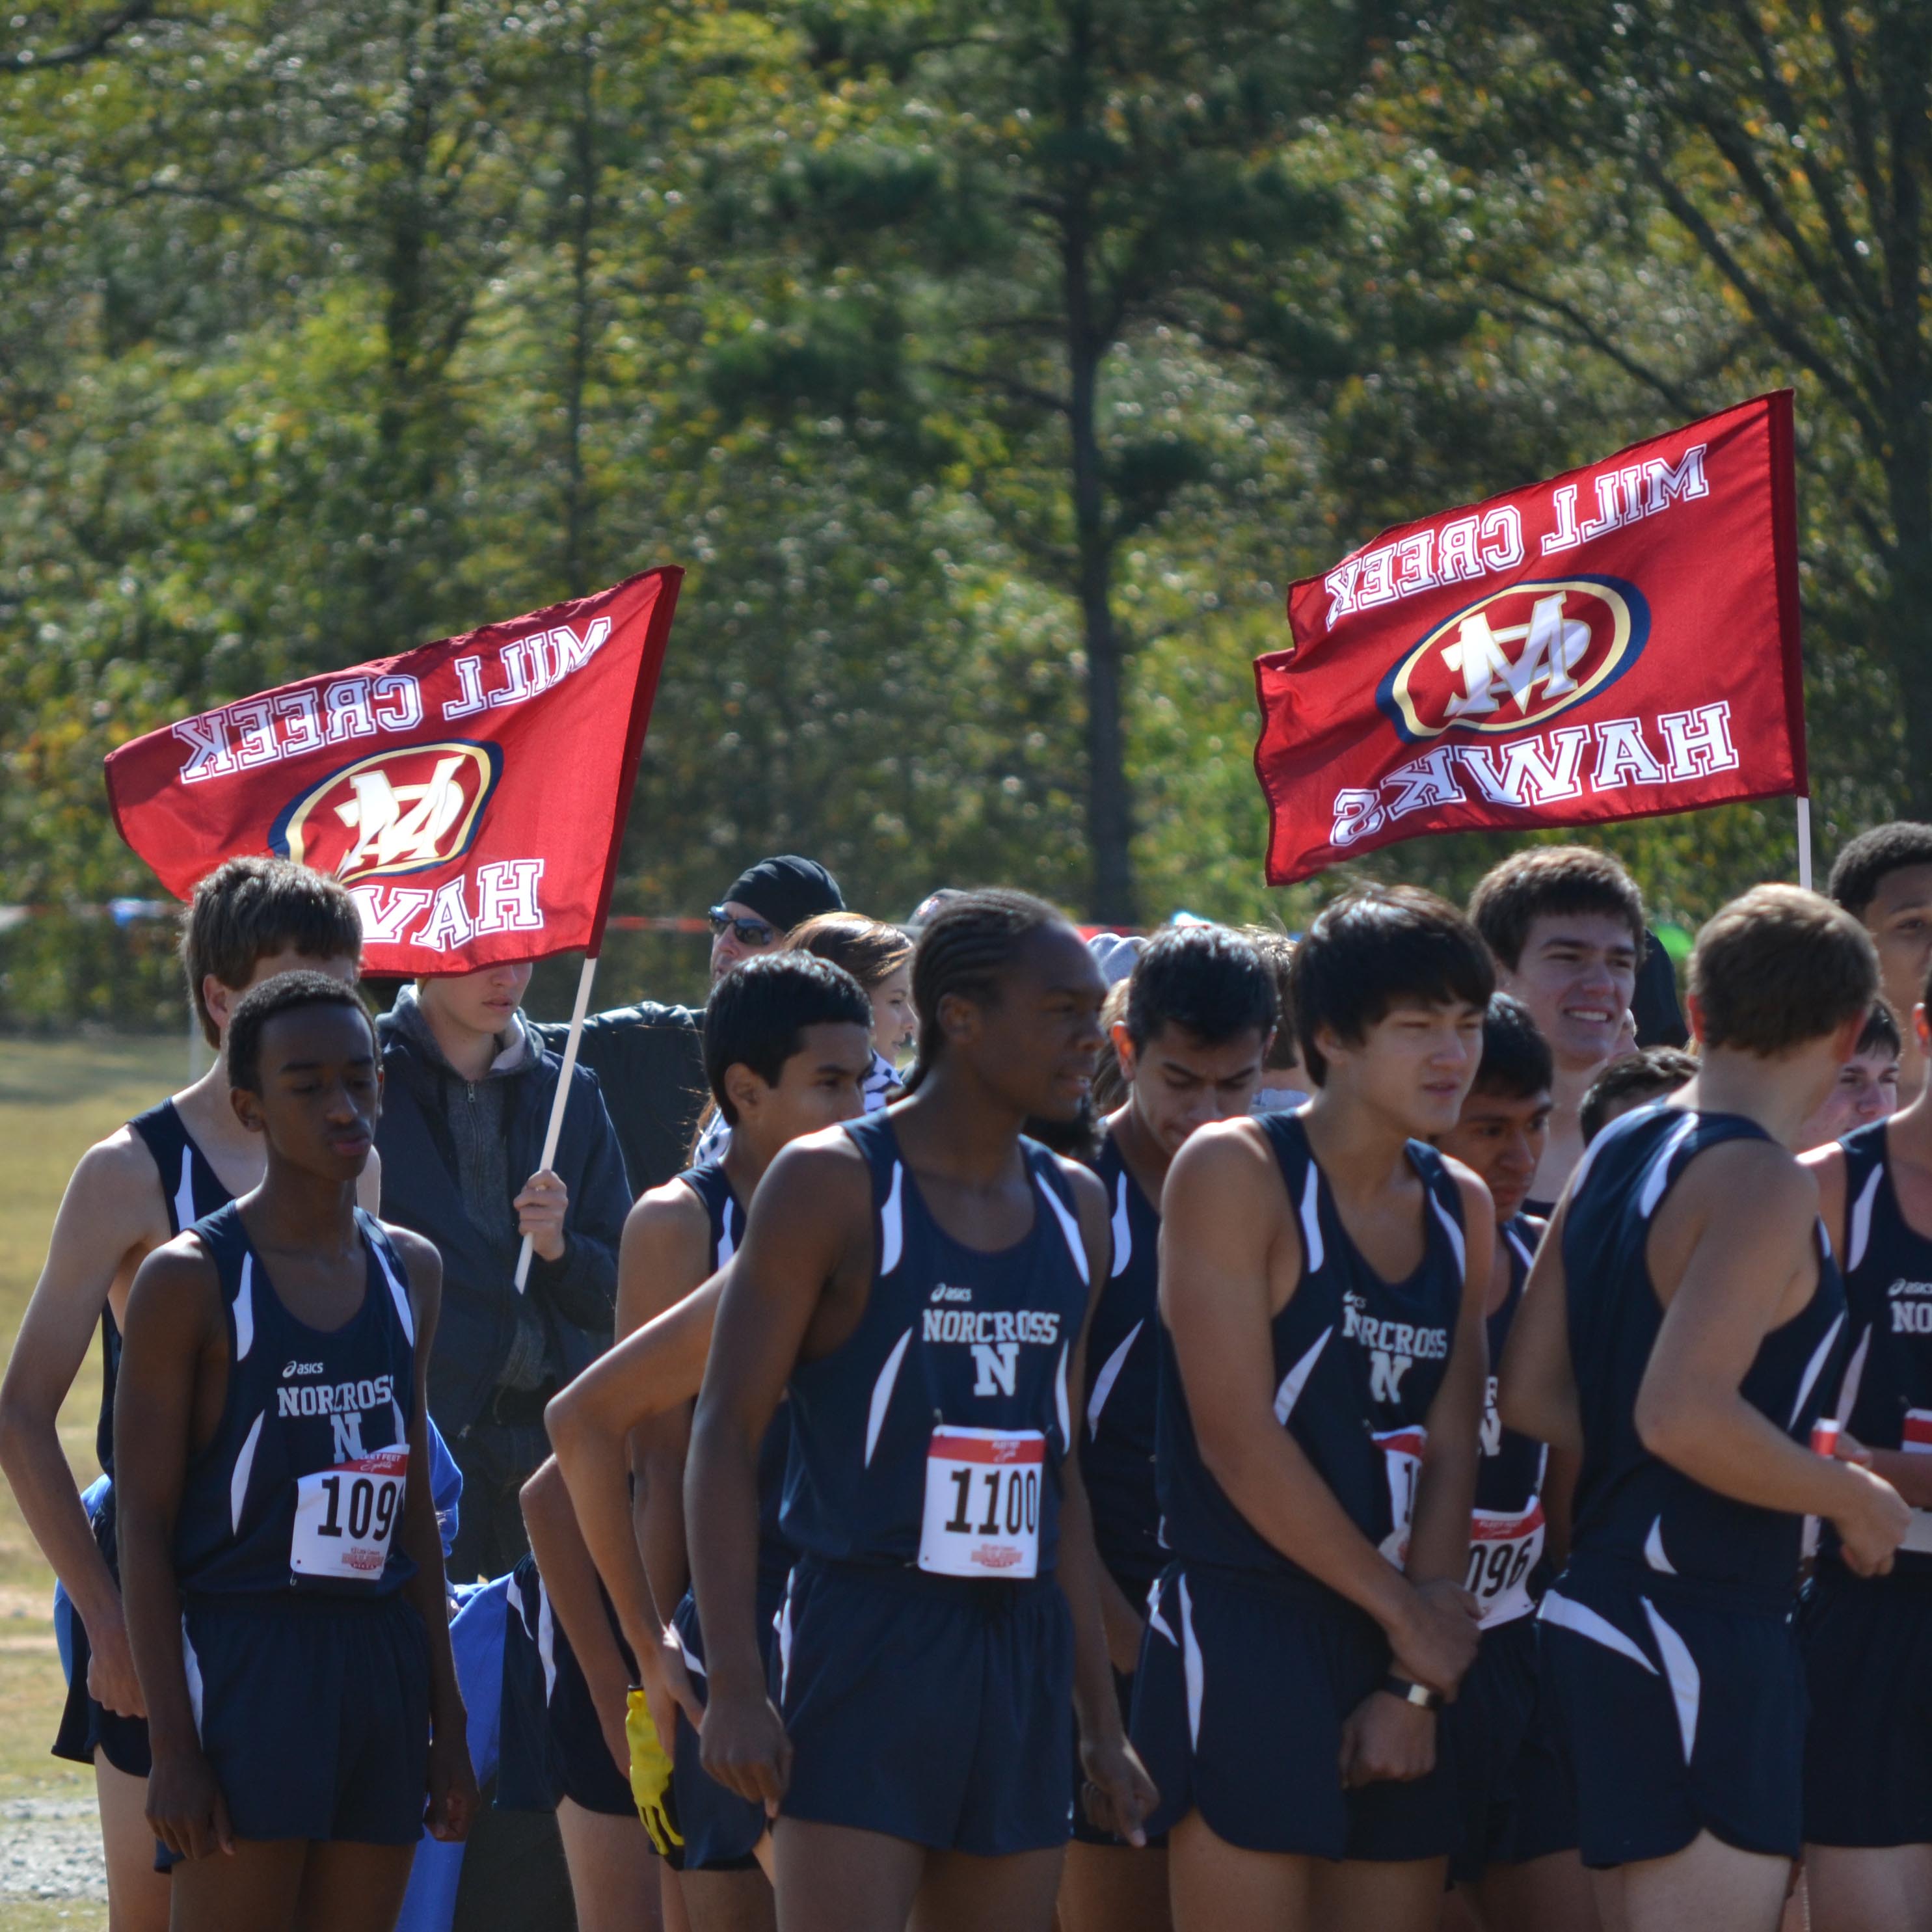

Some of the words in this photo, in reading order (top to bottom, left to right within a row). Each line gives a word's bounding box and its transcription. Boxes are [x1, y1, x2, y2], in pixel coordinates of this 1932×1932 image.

[922, 1309, 1060, 1345] NORCROSS
[1342, 1306, 1447, 1359] NRCROSS
[277, 1375, 394, 1417] NORCROS
[971, 1342, 1019, 1397] N
[1371, 1350, 1412, 1404] N
[330, 1412, 368, 1464] N
[317, 1475, 405, 1541] 109
[945, 1468, 1037, 1535] 1100
[1467, 1536, 1534, 1598] 096
